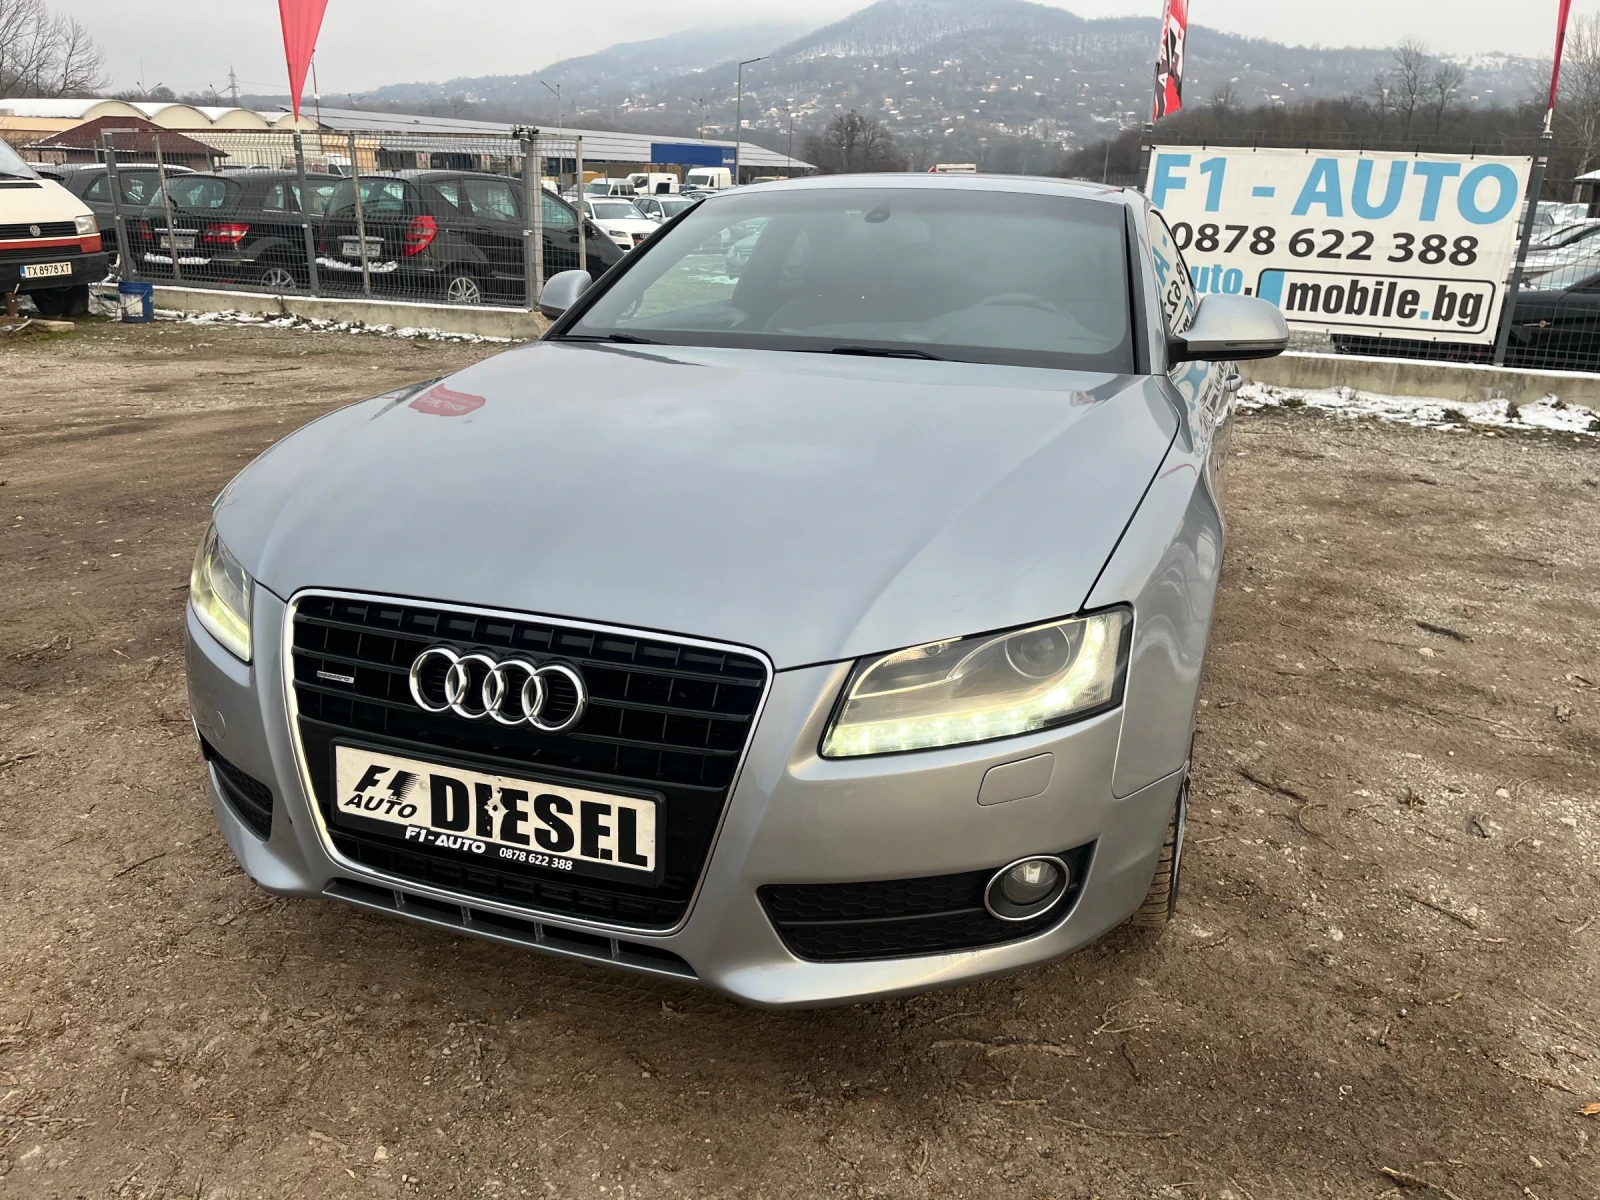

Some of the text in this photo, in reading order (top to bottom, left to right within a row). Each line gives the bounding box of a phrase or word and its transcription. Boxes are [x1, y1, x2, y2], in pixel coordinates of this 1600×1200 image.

[1152, 154, 1227, 212] F1
[1291, 157, 1519, 225] AUTO
[1171, 222, 1479, 266] 0878 622 388
[26, 263, 70, 276] TX 8978 XT
[1285, 278, 1484, 328] mobile.bg
[353, 764, 421, 803] F1
[343, 793, 418, 819] AUTO
[429, 773, 648, 868] DIESEL
[404, 826, 486, 854] F1-AUTO
[499, 847, 573, 871] 0878 622 388
